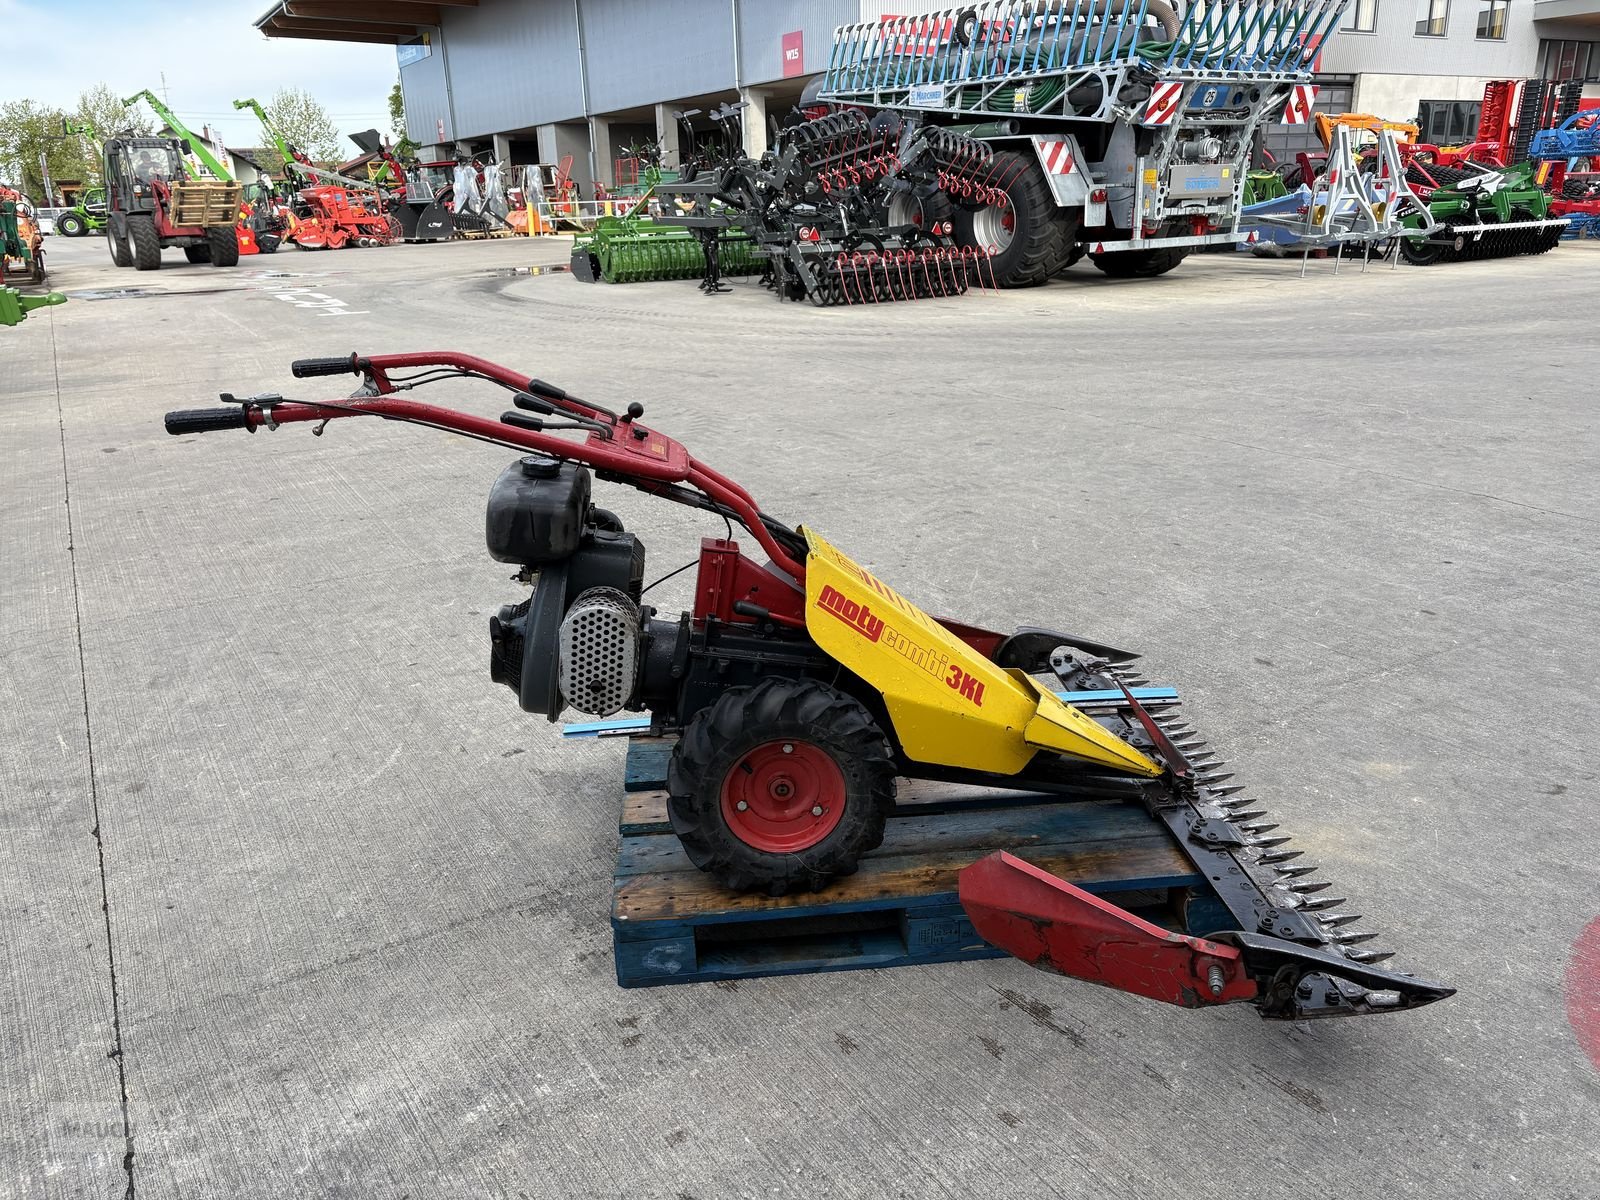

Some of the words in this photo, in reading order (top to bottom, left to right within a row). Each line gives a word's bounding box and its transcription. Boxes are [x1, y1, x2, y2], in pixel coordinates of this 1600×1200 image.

[786, 48, 799, 61] W15
[1204, 91, 1216, 103] 25
[945, 664, 986, 708] 3KL
